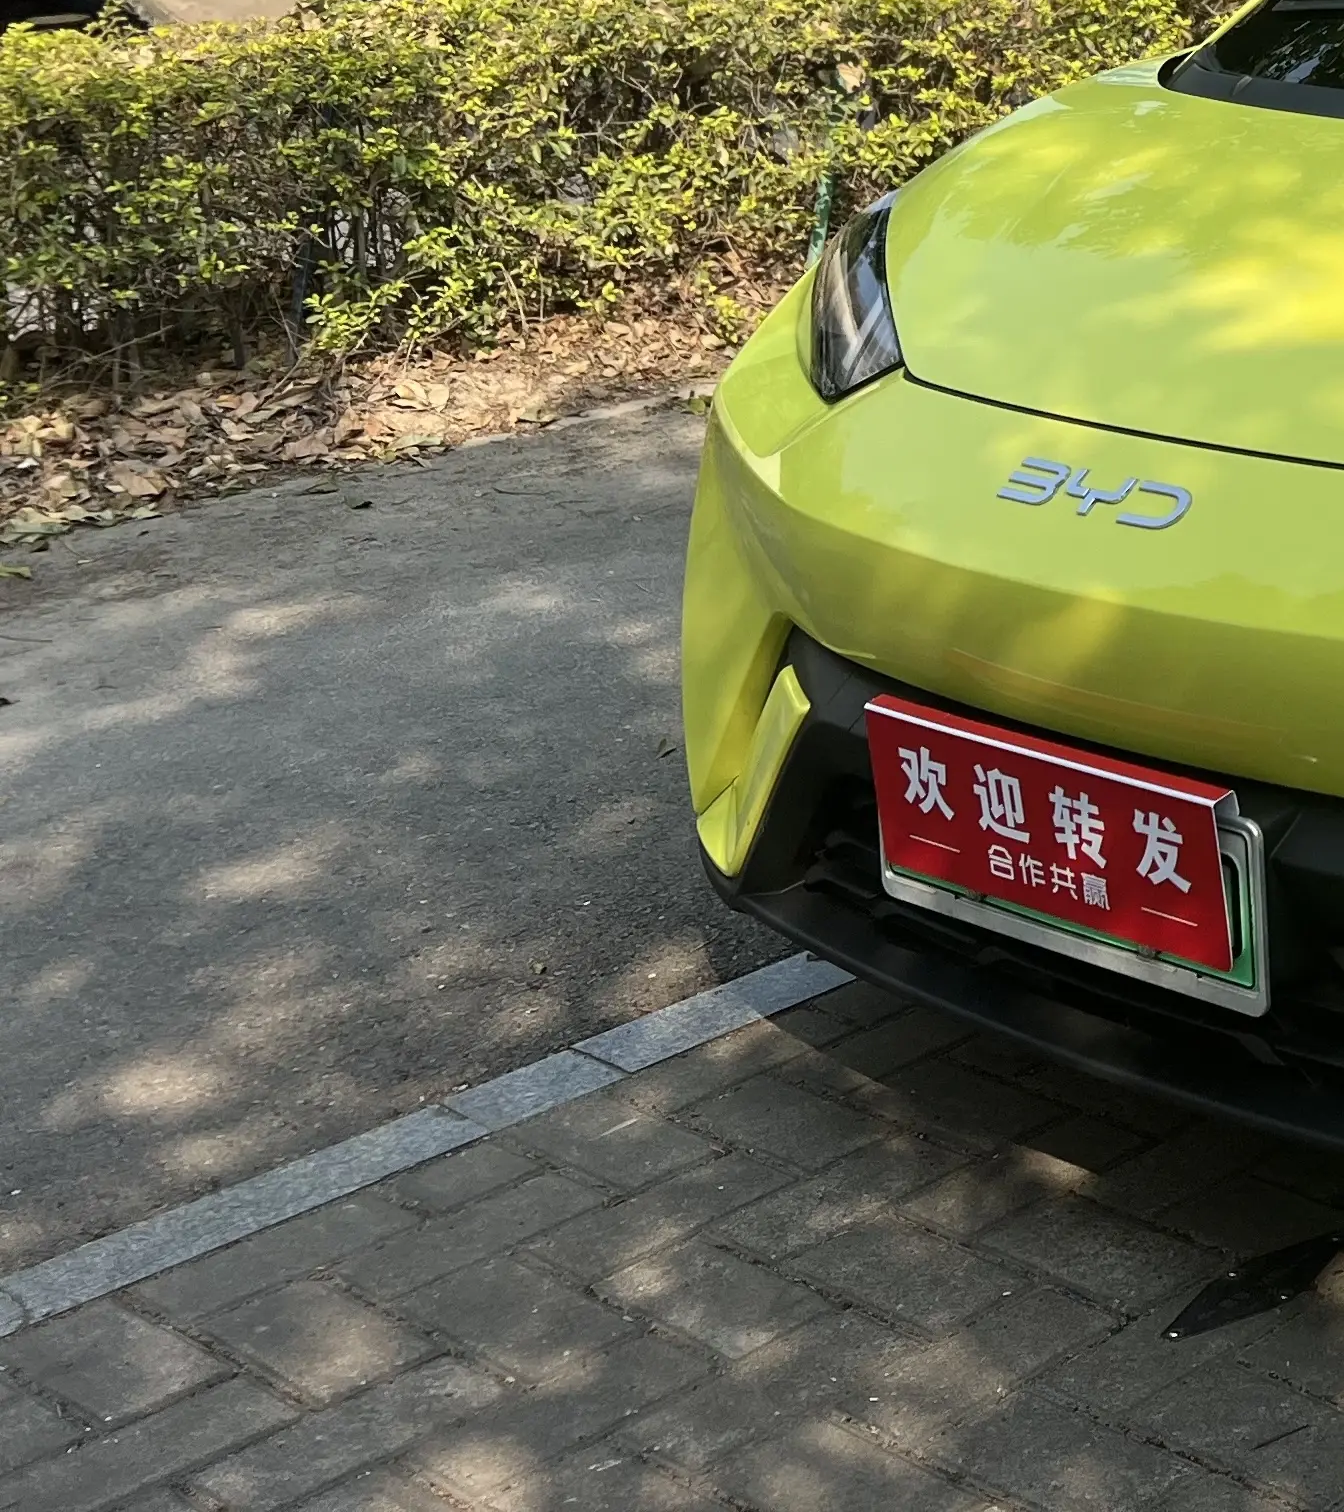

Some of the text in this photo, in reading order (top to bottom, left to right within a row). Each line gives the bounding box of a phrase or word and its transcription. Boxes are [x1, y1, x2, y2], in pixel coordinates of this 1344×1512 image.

[996, 455, 1192, 530] BYD
[898, 746, 1192, 894] 欢迎转发
[987, 844, 1110, 911] 合作共赢
